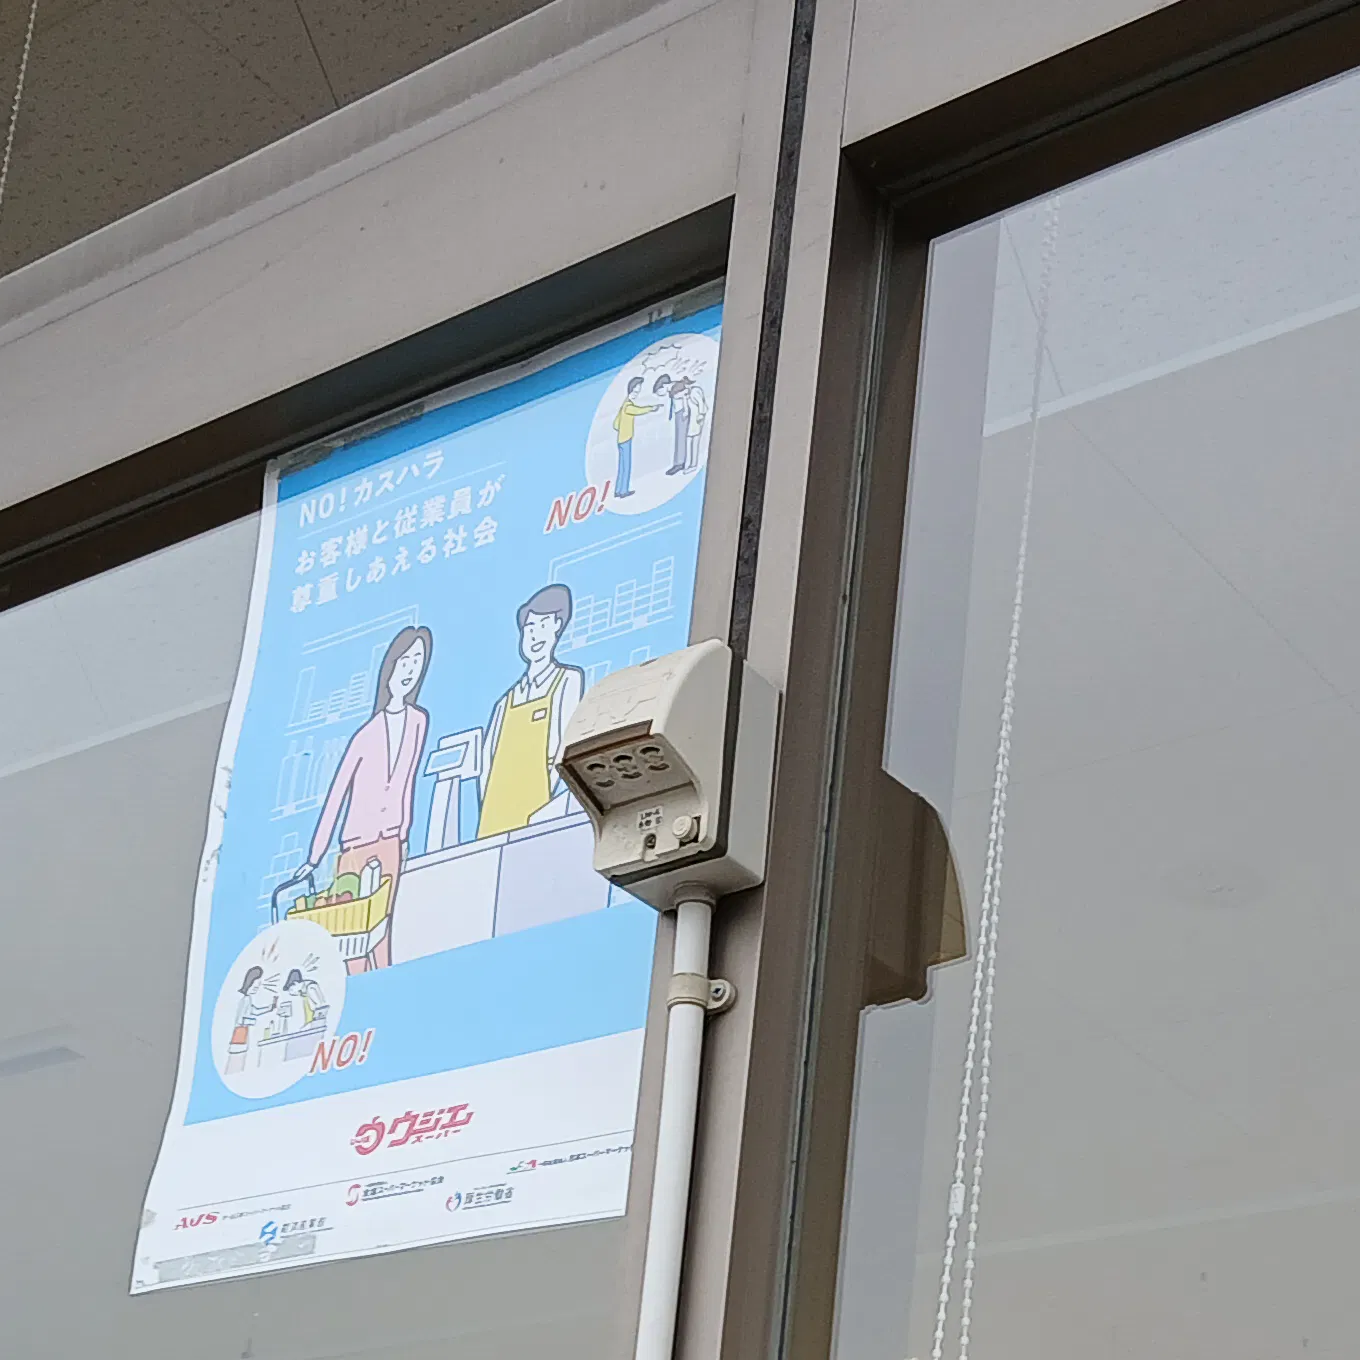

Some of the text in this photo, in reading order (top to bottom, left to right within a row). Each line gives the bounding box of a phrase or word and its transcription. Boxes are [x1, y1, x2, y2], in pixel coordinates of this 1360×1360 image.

[295, 474, 507, 575] お客様と従業員が
[543, 480, 612, 534] NO!
[290, 515, 498, 613] 尊重しあえる社会
[308, 1029, 375, 1074] NO!
